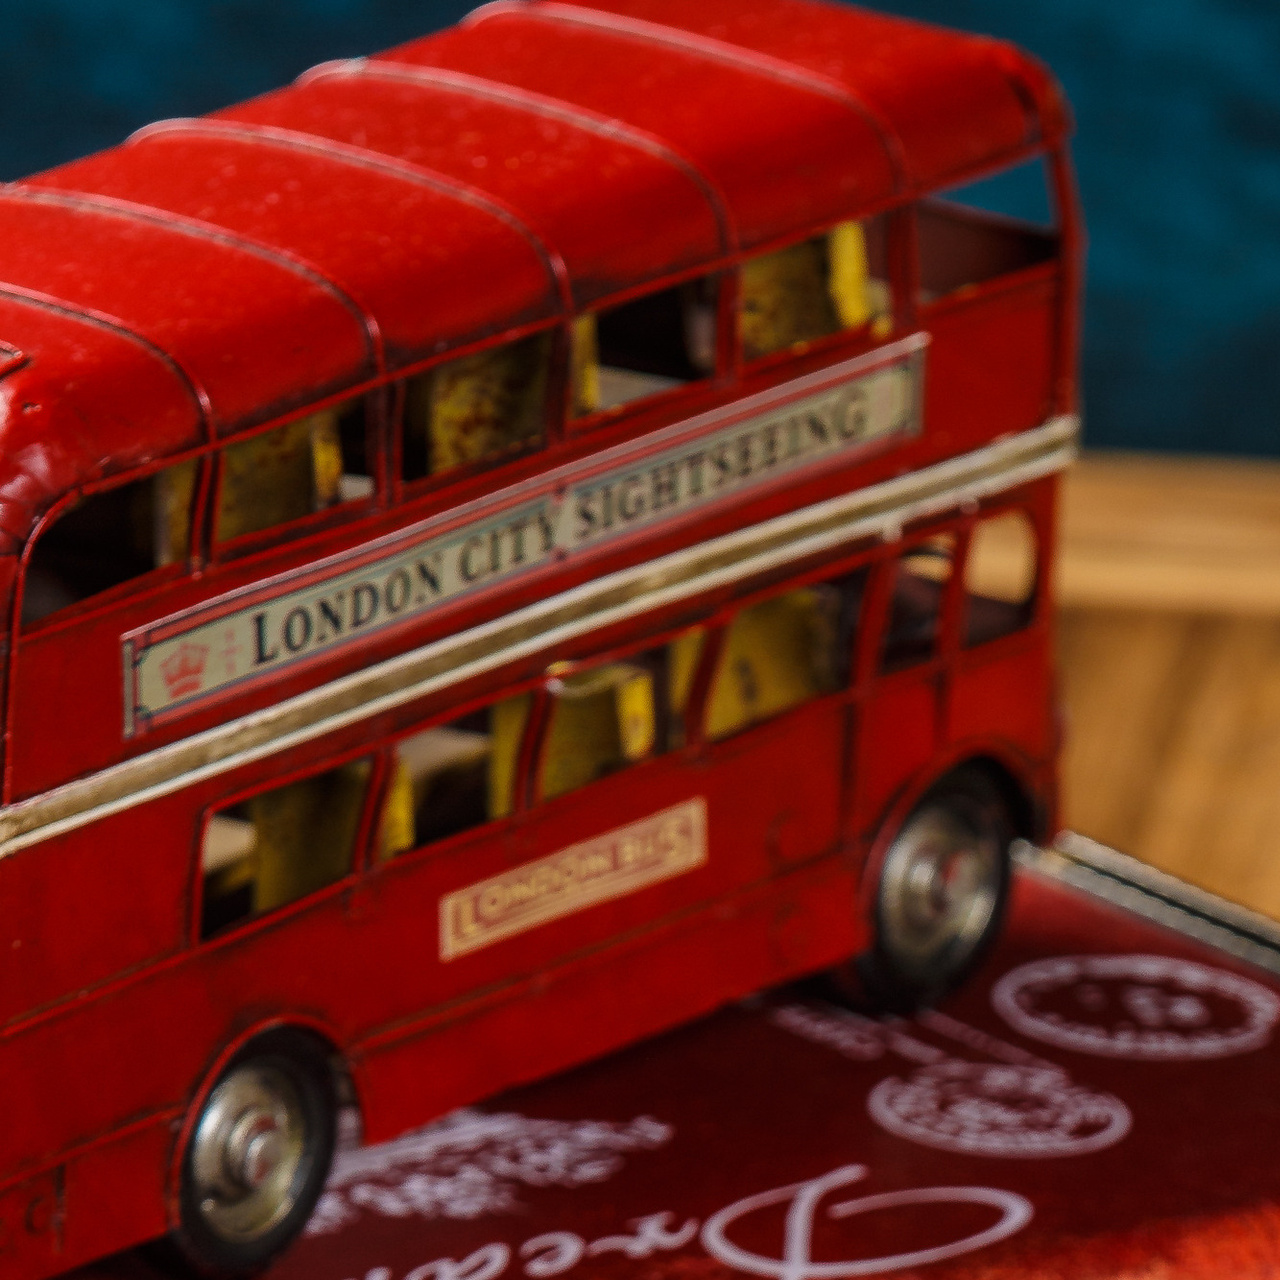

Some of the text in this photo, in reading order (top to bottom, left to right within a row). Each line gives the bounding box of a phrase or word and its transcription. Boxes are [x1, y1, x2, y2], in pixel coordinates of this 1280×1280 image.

[252, 384, 867, 664] LONDON CITY SIGHTSEEING
